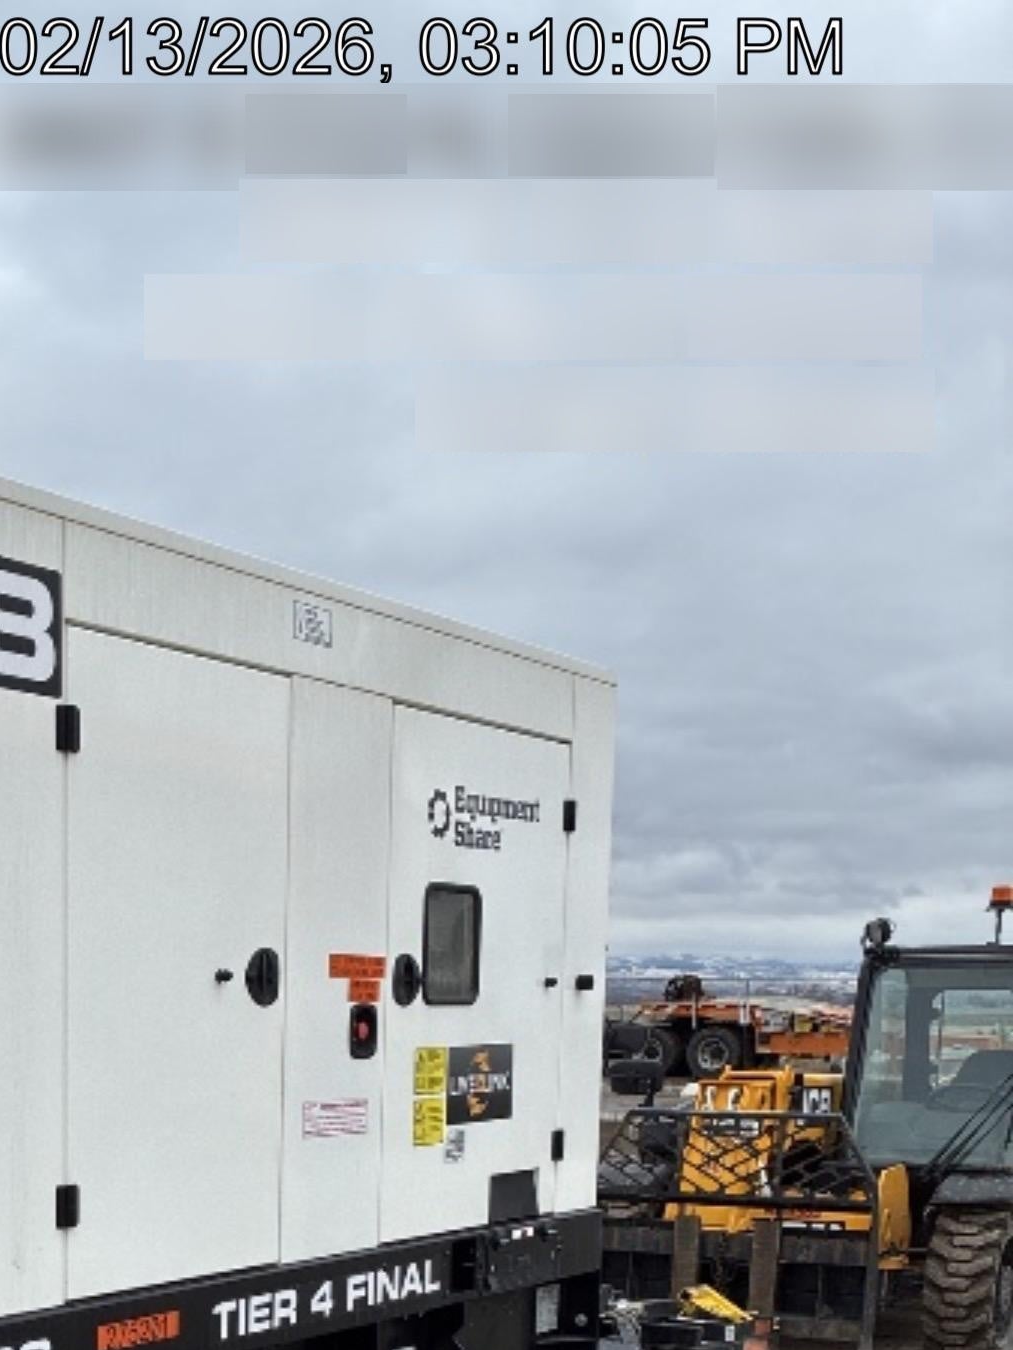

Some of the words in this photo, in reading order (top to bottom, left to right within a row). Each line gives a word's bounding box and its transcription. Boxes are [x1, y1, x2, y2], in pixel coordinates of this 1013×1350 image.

[454, 784, 540, 823] Equipment
[212, 1289, 297, 1339] TIER
[310, 1280, 333, 1317] 4
[346, 1259, 441, 1312] FINAL
